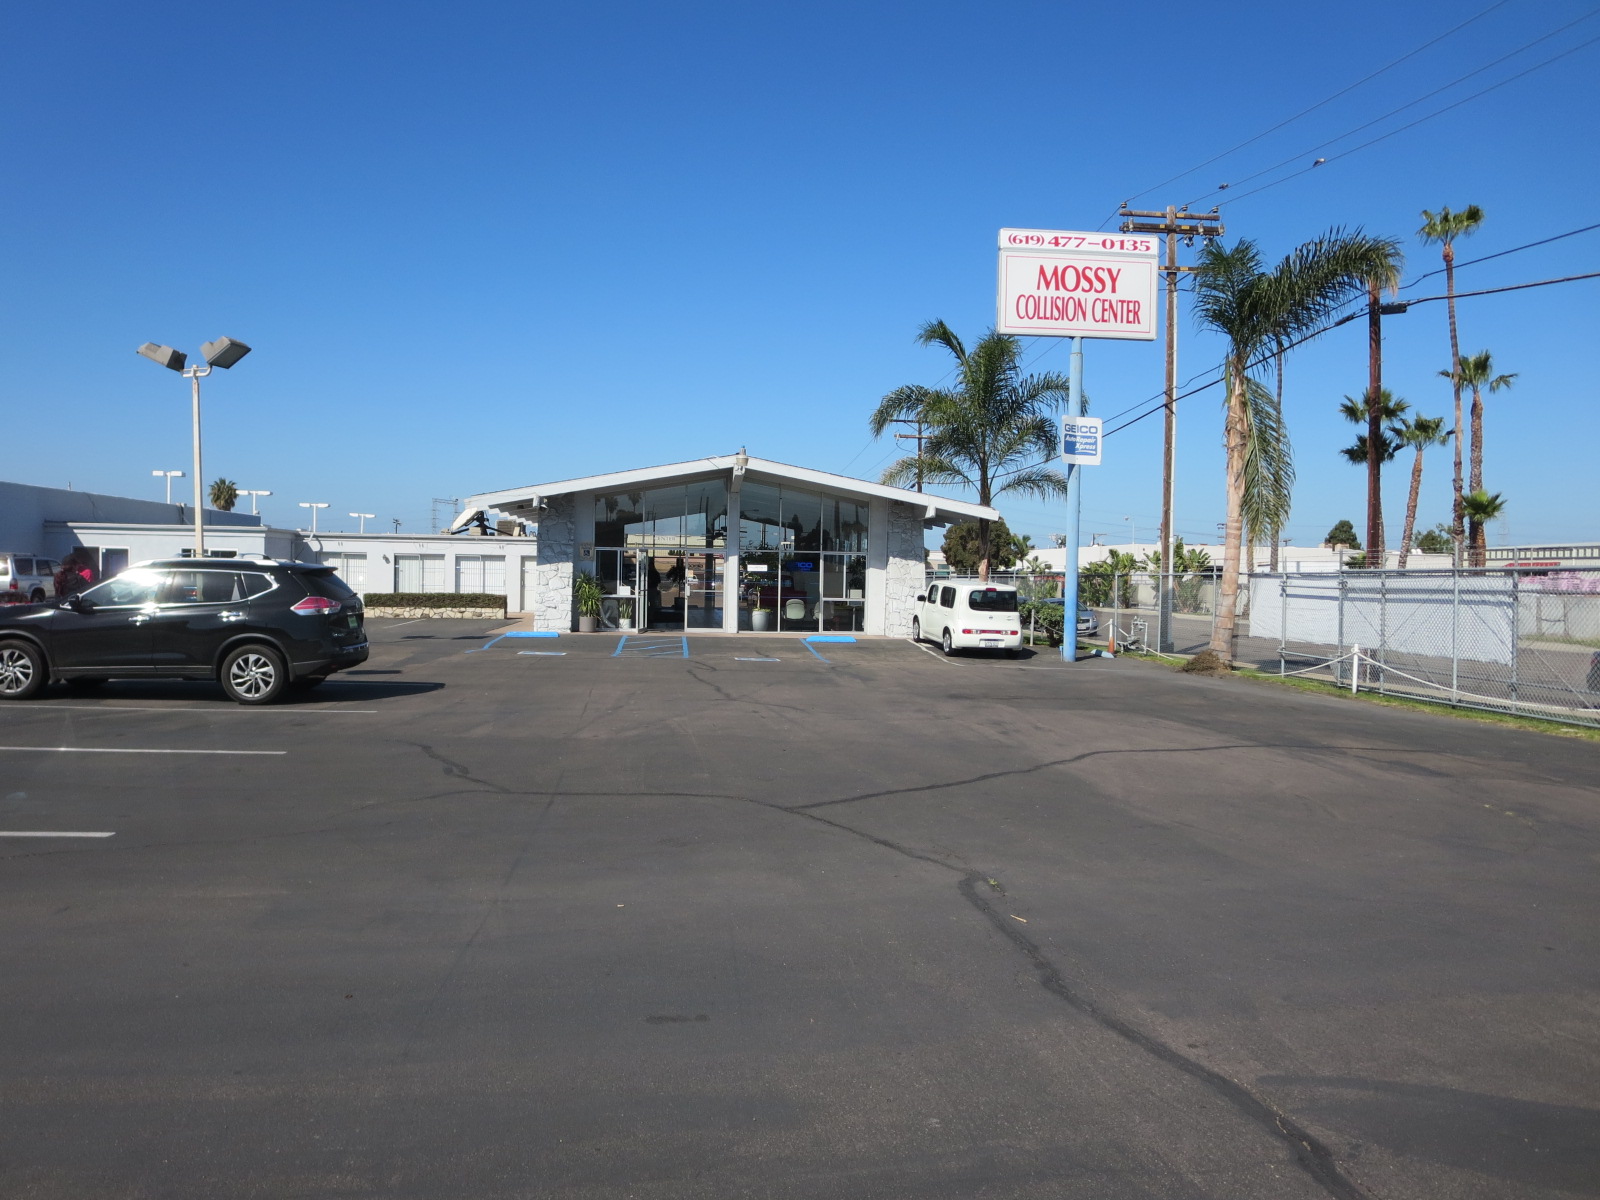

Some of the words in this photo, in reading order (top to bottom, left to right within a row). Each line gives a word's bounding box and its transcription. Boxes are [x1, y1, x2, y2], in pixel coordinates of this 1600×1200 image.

[1008, 233, 1045, 247] (619)
[1048, 236, 1151, 252] 477-0135
[1036, 264, 1122, 294] MOSSY
[1016, 294, 1087, 322] COLLISION
[1092, 297, 1141, 325] CENTER
[1064, 423, 1099, 435] GEICO
